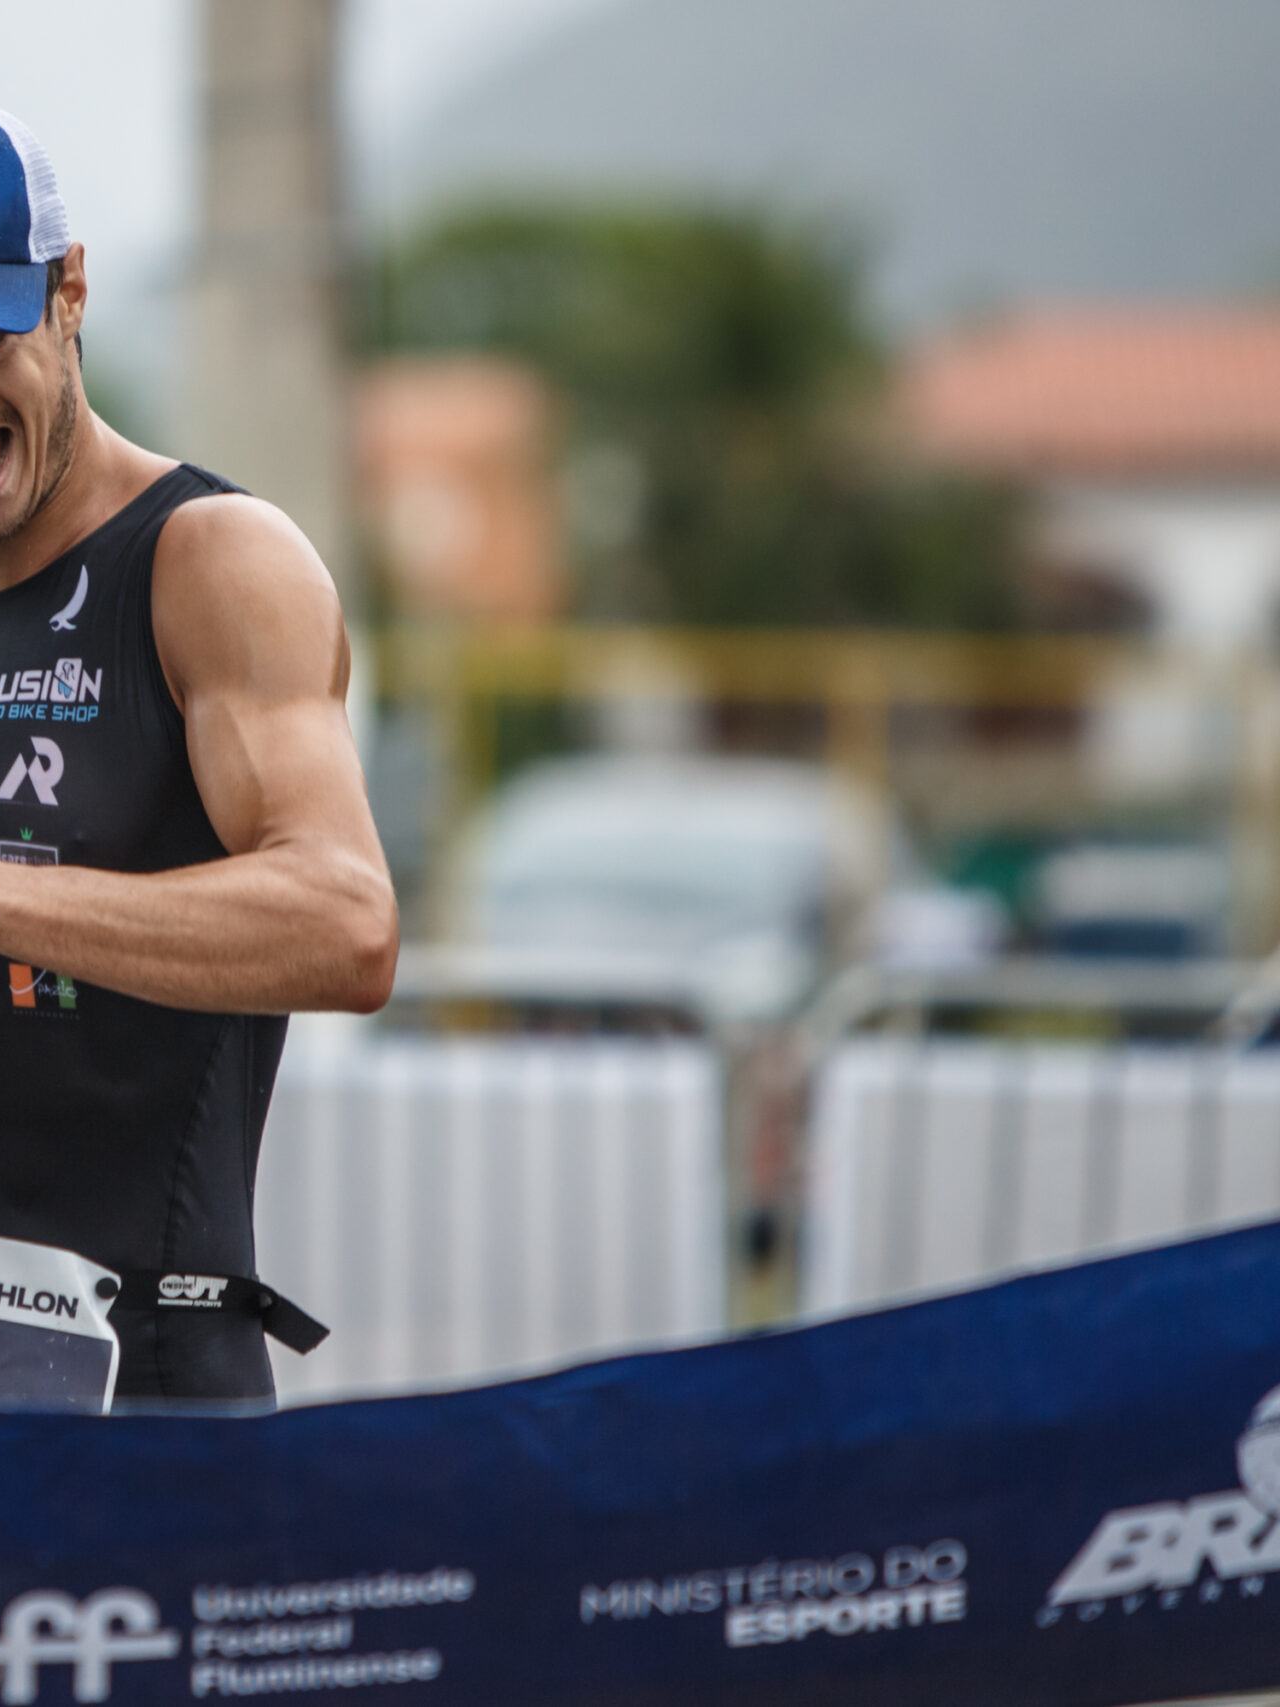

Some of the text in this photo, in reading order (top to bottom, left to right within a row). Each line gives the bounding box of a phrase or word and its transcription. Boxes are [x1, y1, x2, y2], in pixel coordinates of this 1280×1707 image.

[7, 703, 48, 720] BIKE
[51, 705, 99, 722] SHOP
[192, 1567, 477, 1623] Universidade
[579, 1538, 968, 1624] MINISTÉRIO DO
[192, 1614, 355, 1660] Federal
[725, 1582, 968, 1648] ESPORTE
[191, 1648, 443, 1699] Fluminense
